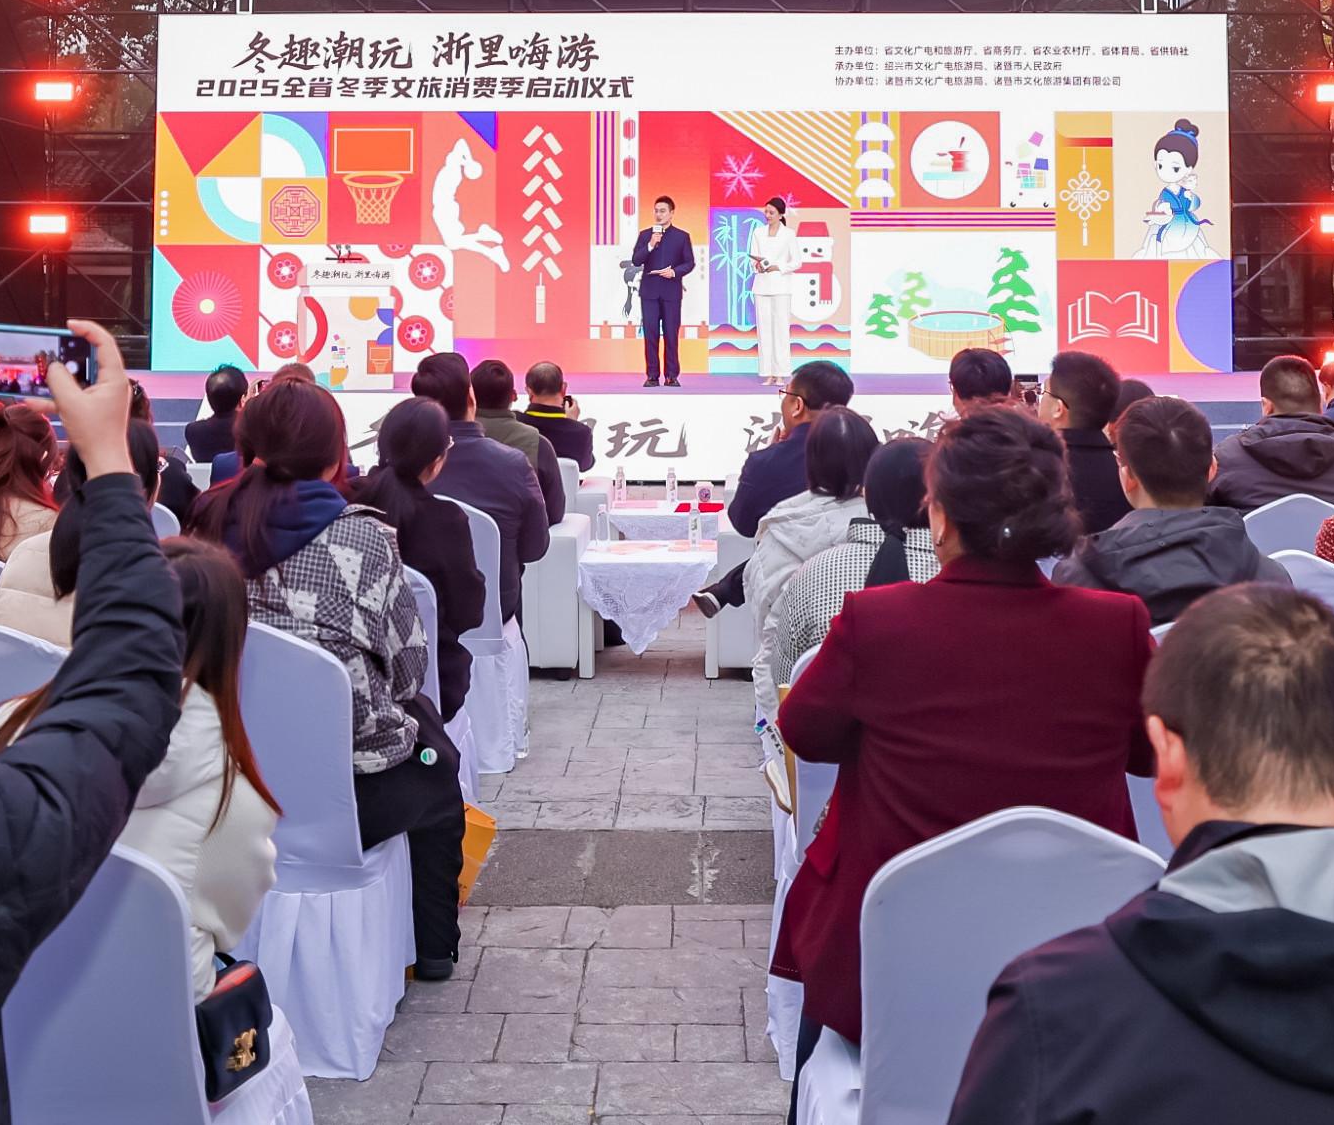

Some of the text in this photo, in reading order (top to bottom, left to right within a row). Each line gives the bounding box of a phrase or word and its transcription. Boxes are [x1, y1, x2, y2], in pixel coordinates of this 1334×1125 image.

[232, 31, 600, 76] 冬趣潮玩 浙里嗨游
[196, 77, 635, 99] 2025全省冬季文旅消费季启动仪式
